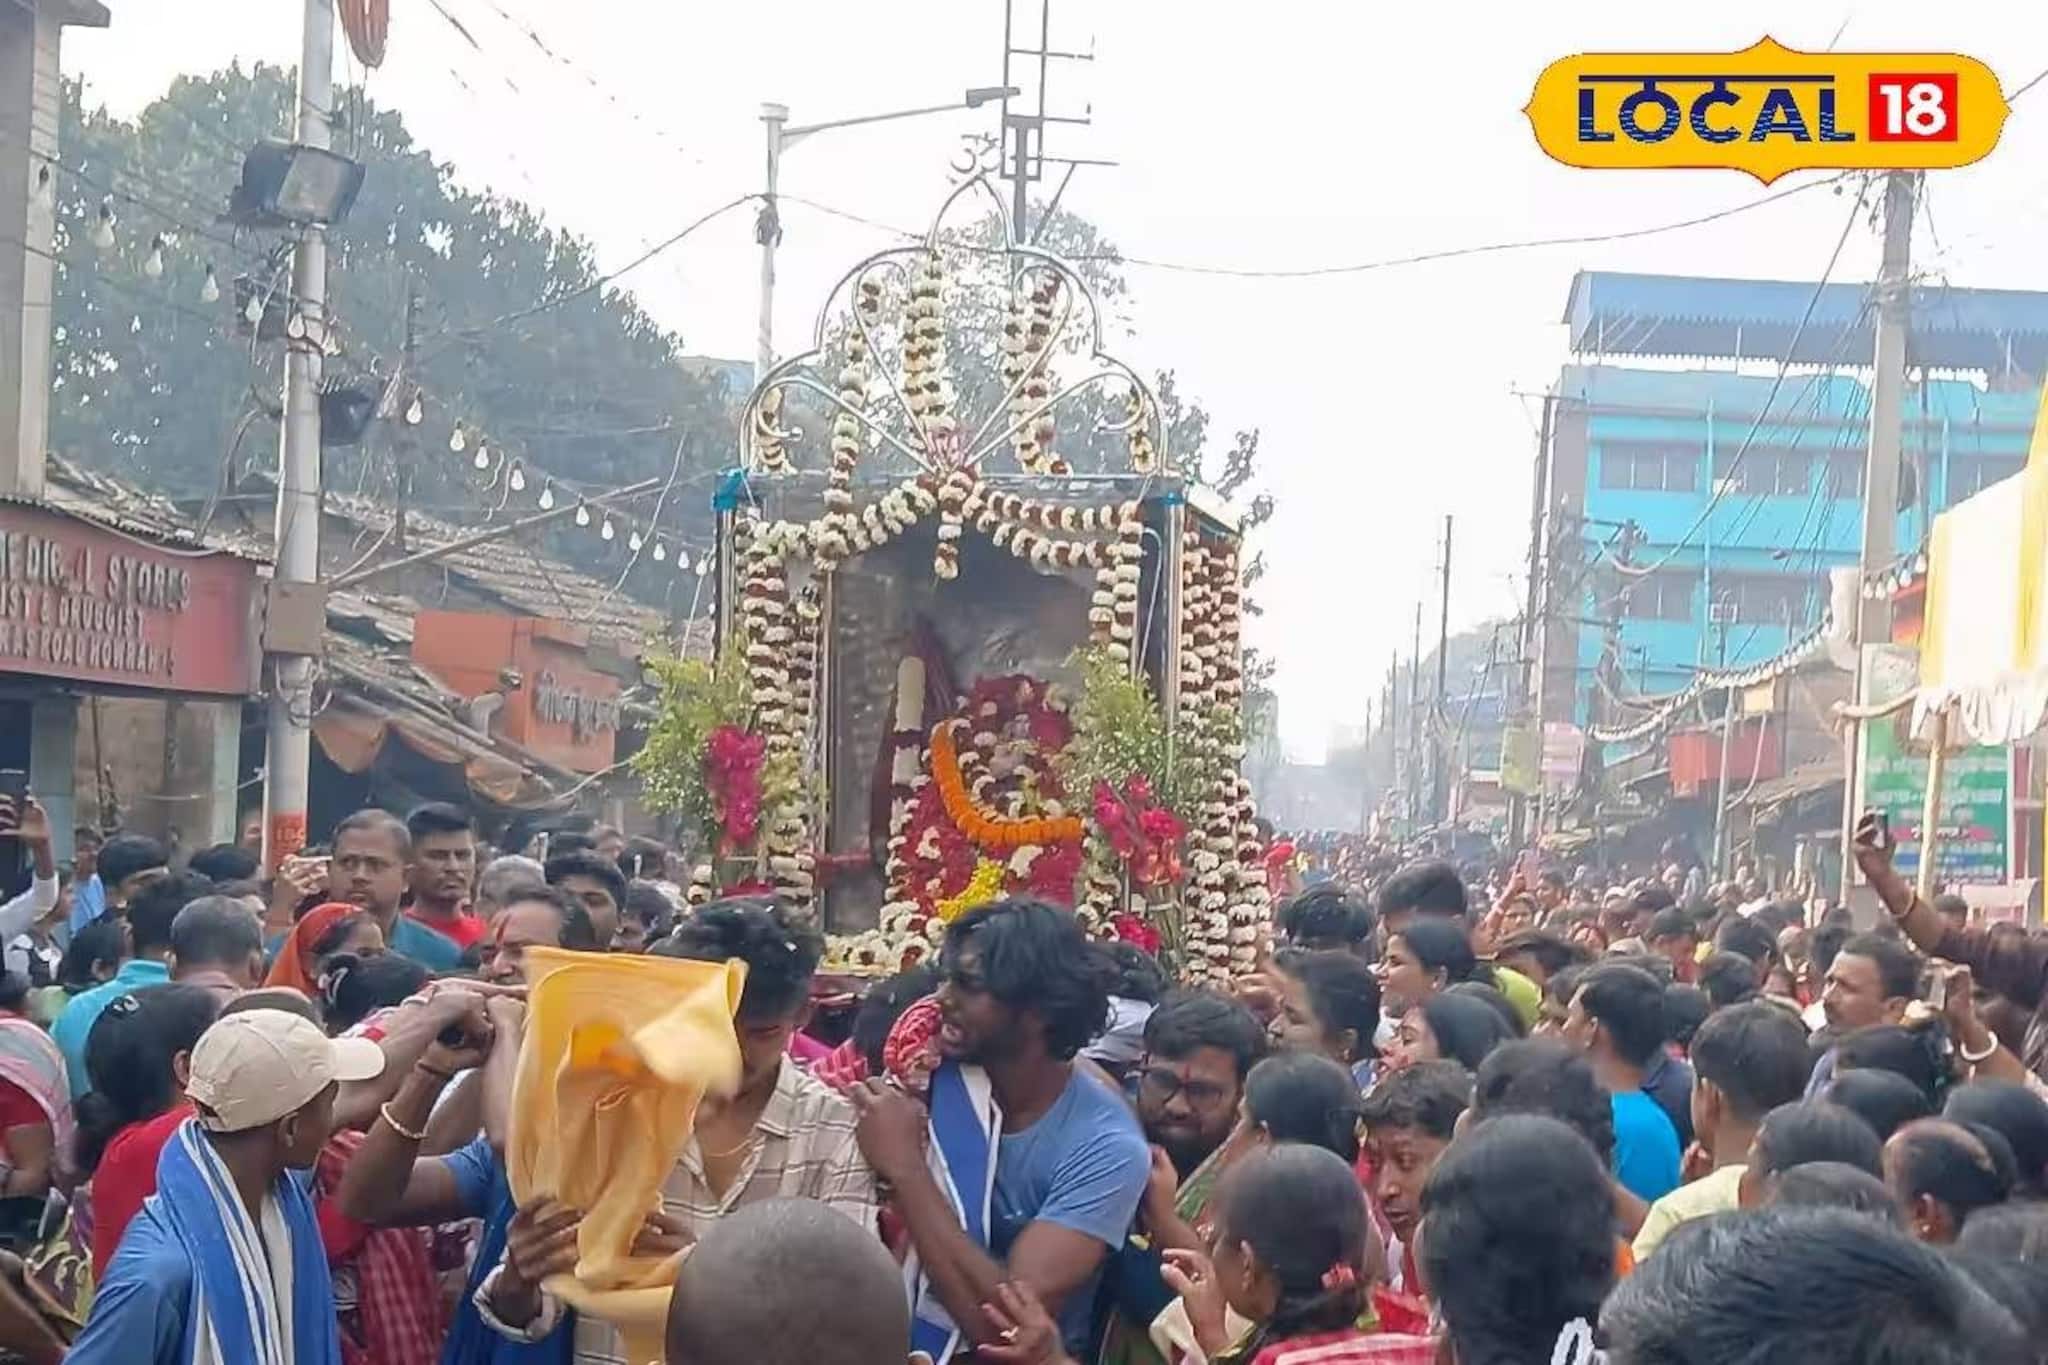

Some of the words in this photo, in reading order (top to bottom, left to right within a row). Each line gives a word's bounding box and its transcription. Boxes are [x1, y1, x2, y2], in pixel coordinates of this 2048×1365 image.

[108, 556, 191, 609] STORES
[0, 582, 32, 619] IST
[60, 595, 145, 639] DRUGGIST
[0, 620, 38, 658] RAS
[40, 627, 87, 664] ROAD
